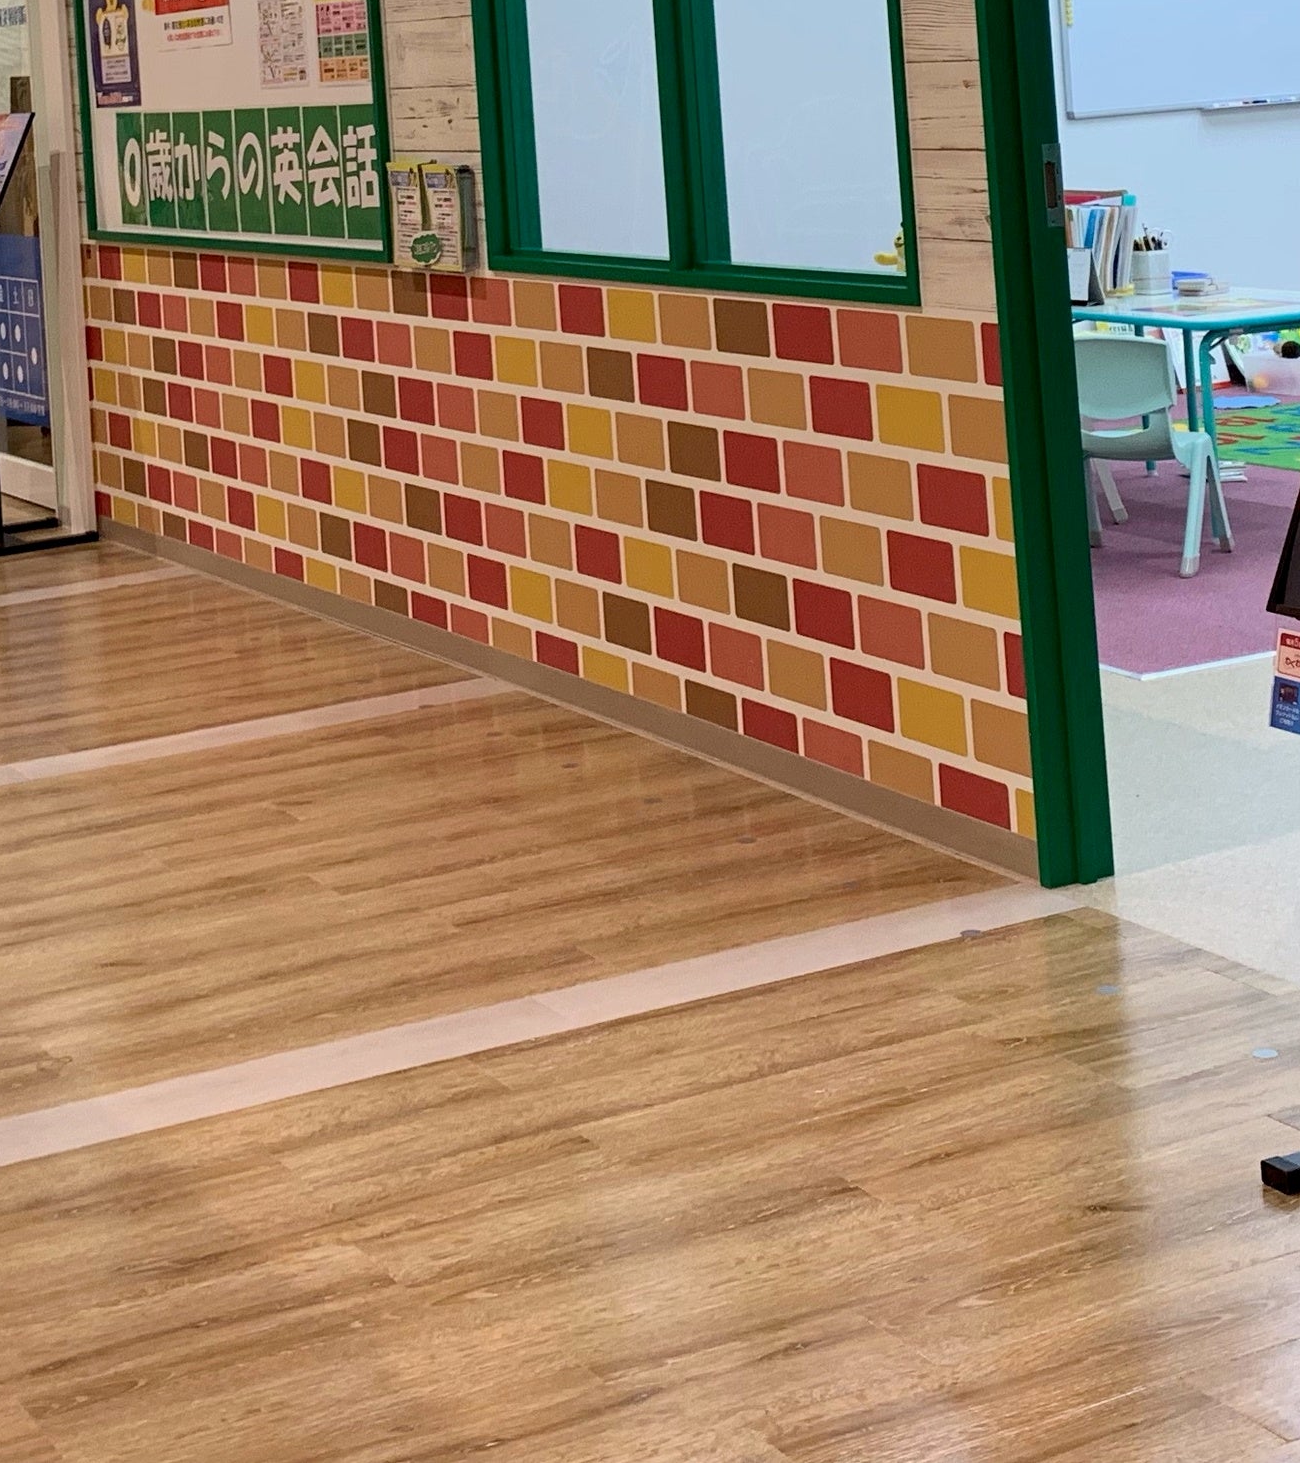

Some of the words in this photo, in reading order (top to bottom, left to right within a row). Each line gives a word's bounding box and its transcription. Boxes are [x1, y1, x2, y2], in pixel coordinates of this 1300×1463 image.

[123, 123, 381, 209] 0歳からの英会話
